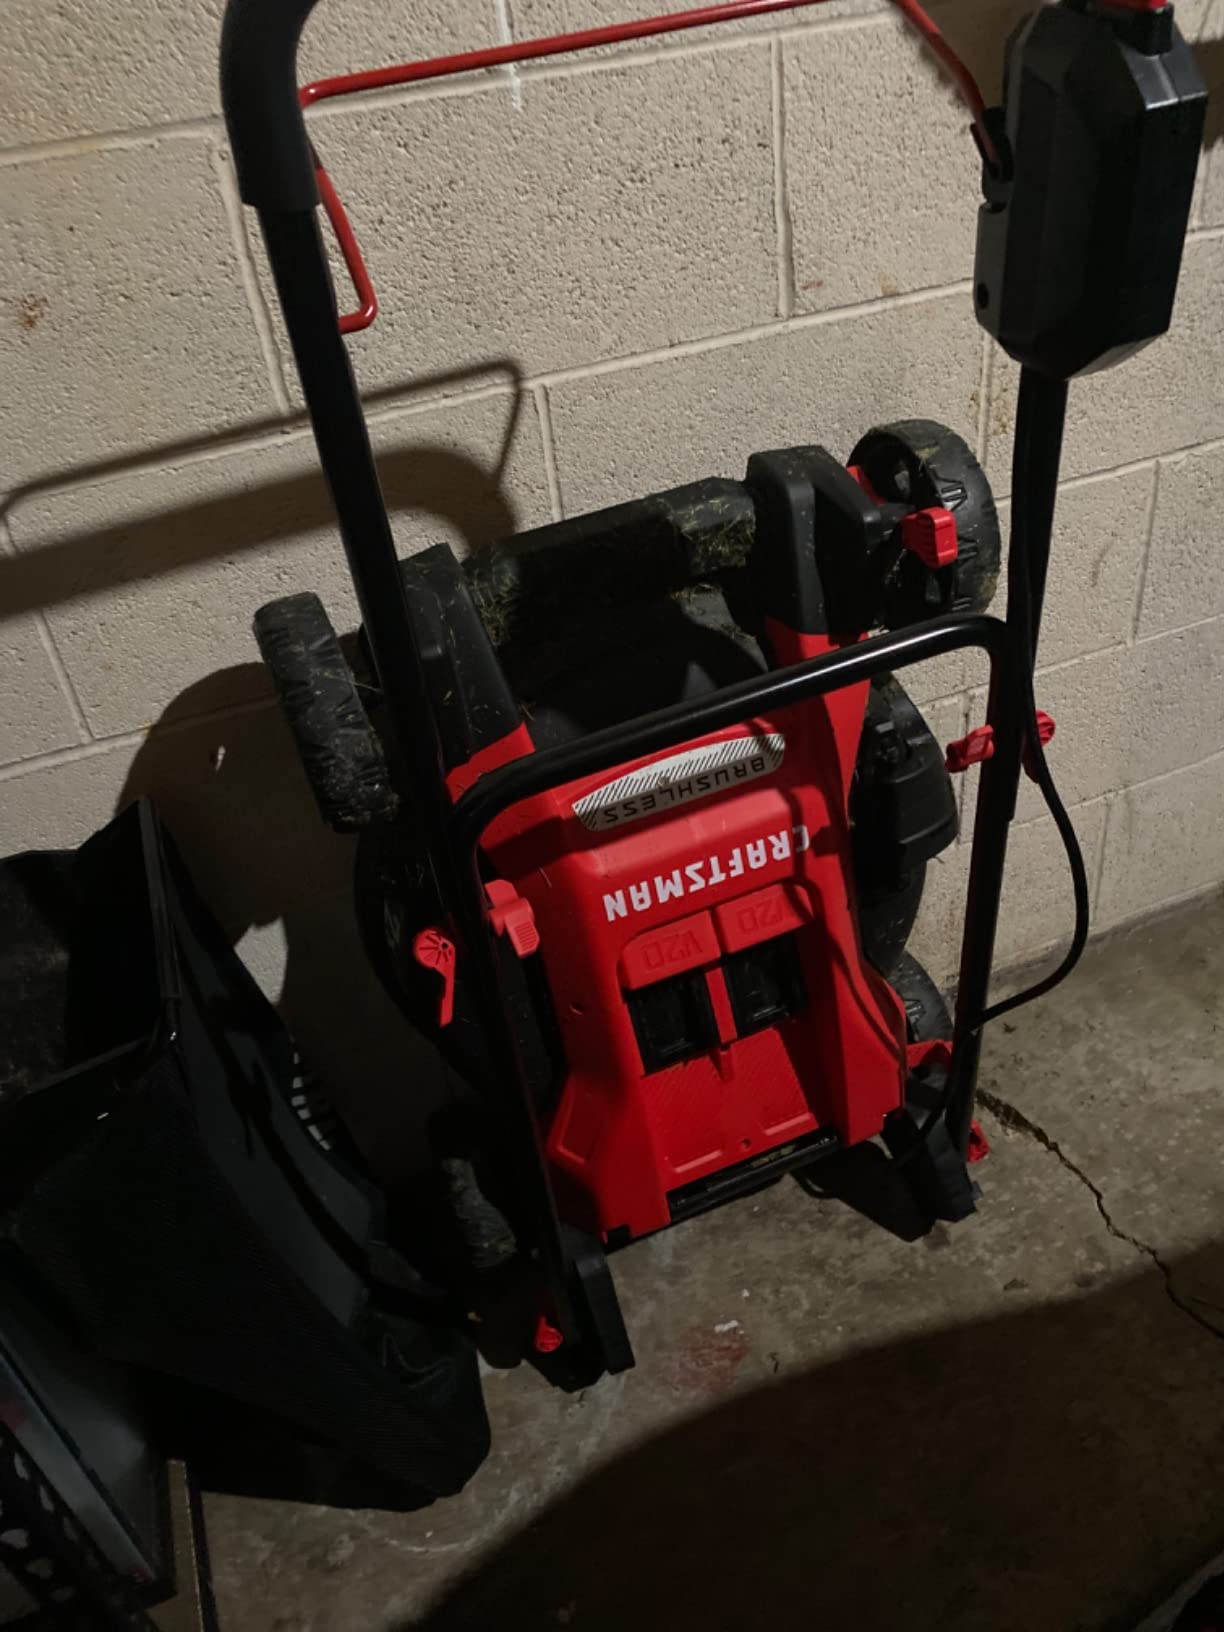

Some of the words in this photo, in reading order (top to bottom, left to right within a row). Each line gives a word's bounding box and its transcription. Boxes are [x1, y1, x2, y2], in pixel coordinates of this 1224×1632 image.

[603, 756, 767, 824] BRUSHLESS
[602, 824, 810, 922] CRAFTSMAN
[642, 929, 703, 969] V20
